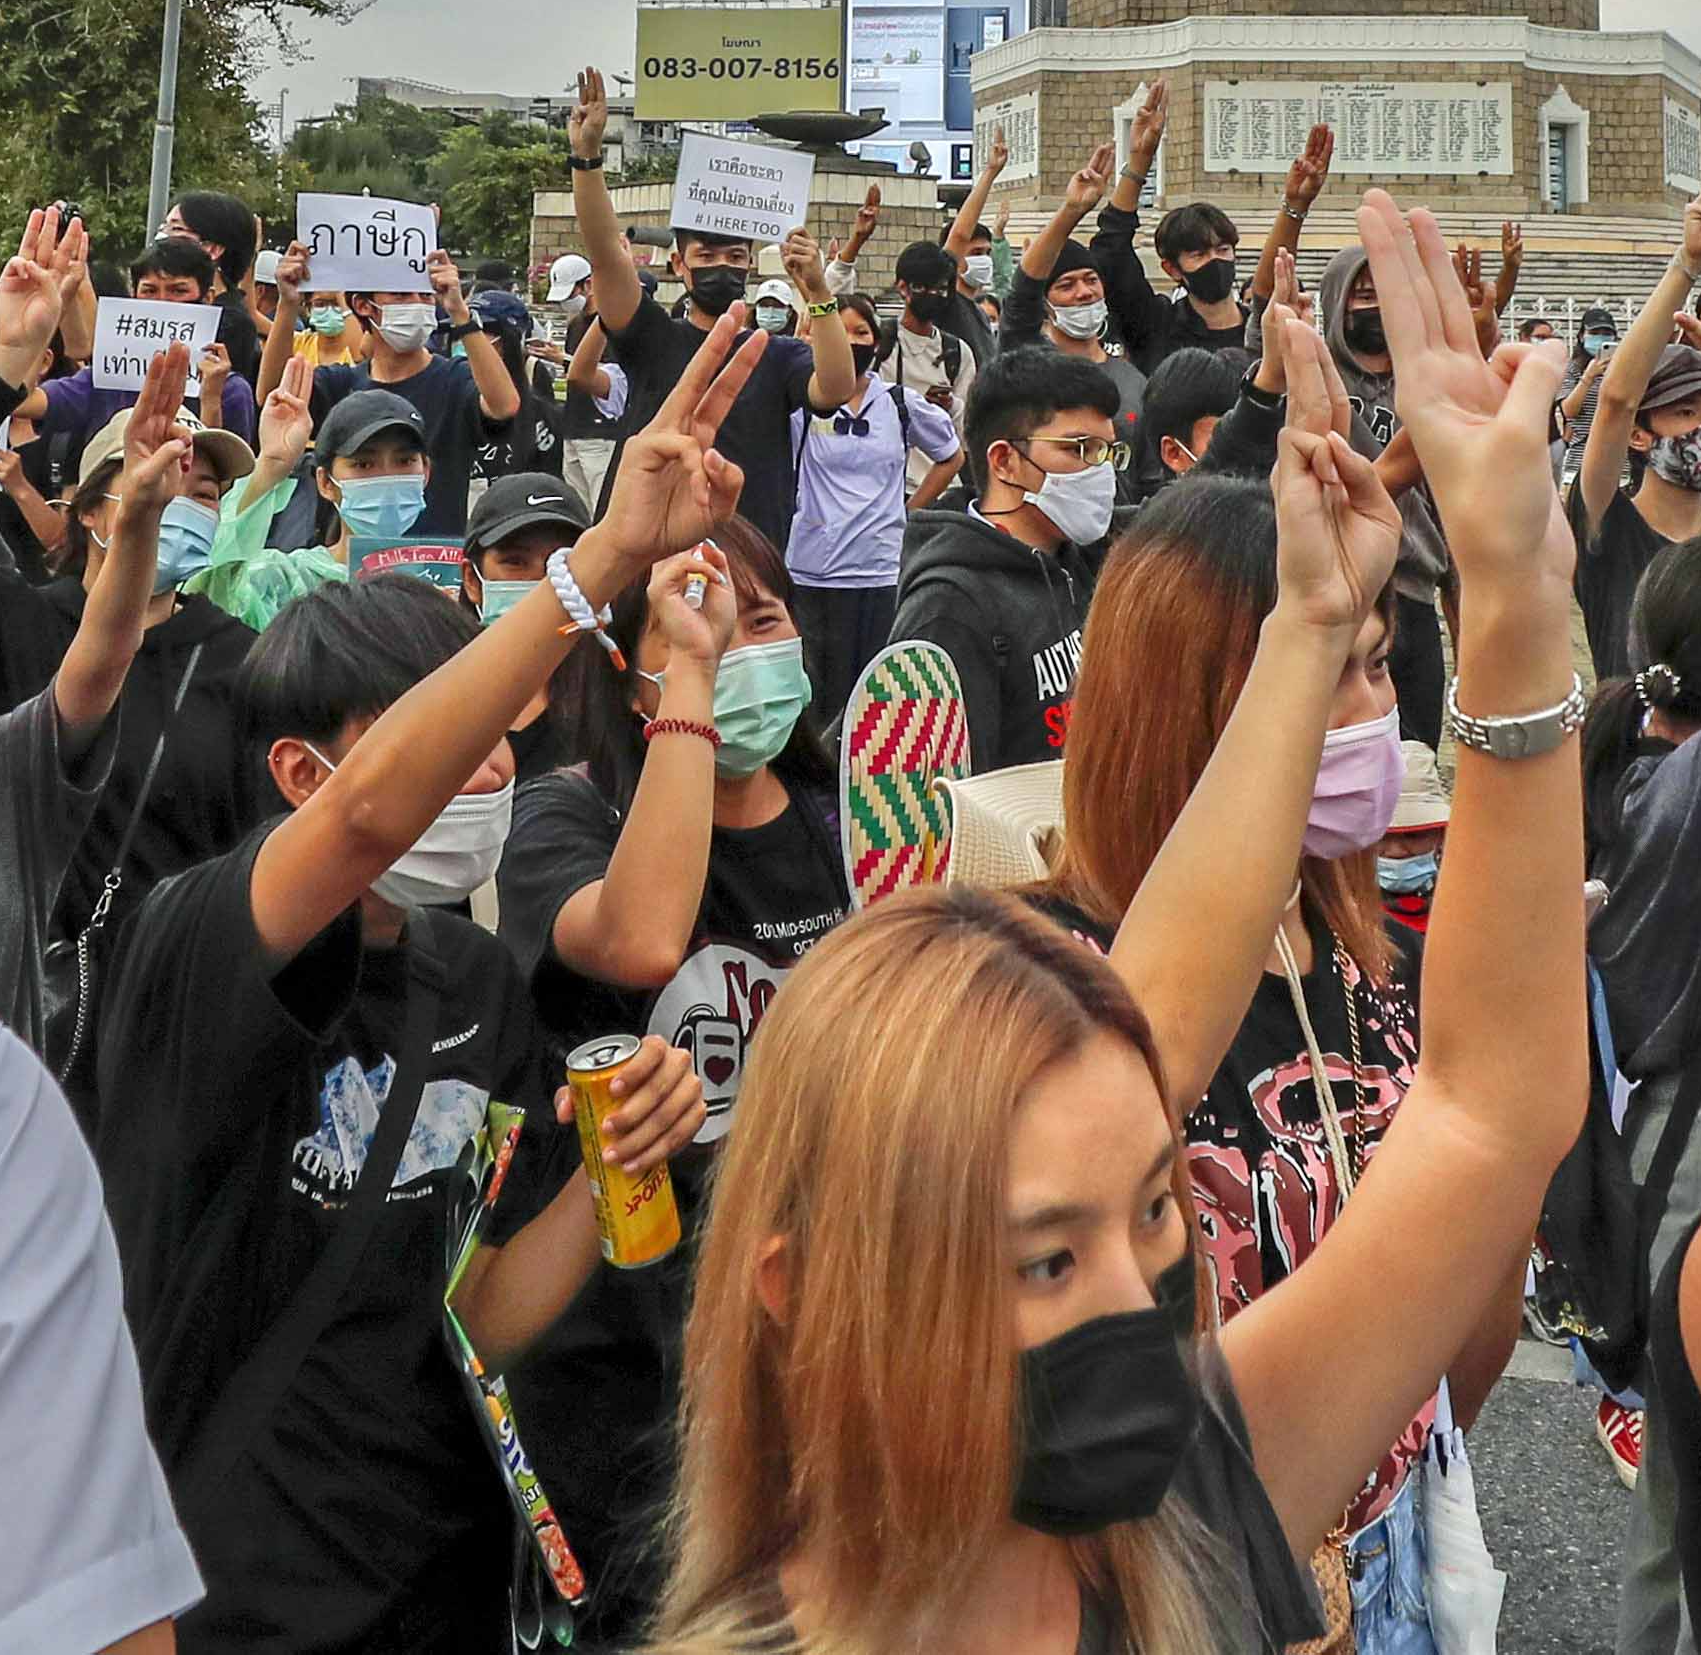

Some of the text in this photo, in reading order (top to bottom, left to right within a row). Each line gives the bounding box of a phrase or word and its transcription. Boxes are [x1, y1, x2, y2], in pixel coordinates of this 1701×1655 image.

[644, 57, 840, 79] 083-007-8156
[714, 216, 749, 232] HERE
[751, 220, 780, 236] TOO
[307, 209, 427, 274] ภาษีกู
[115, 314, 196, 341] #สมรส
